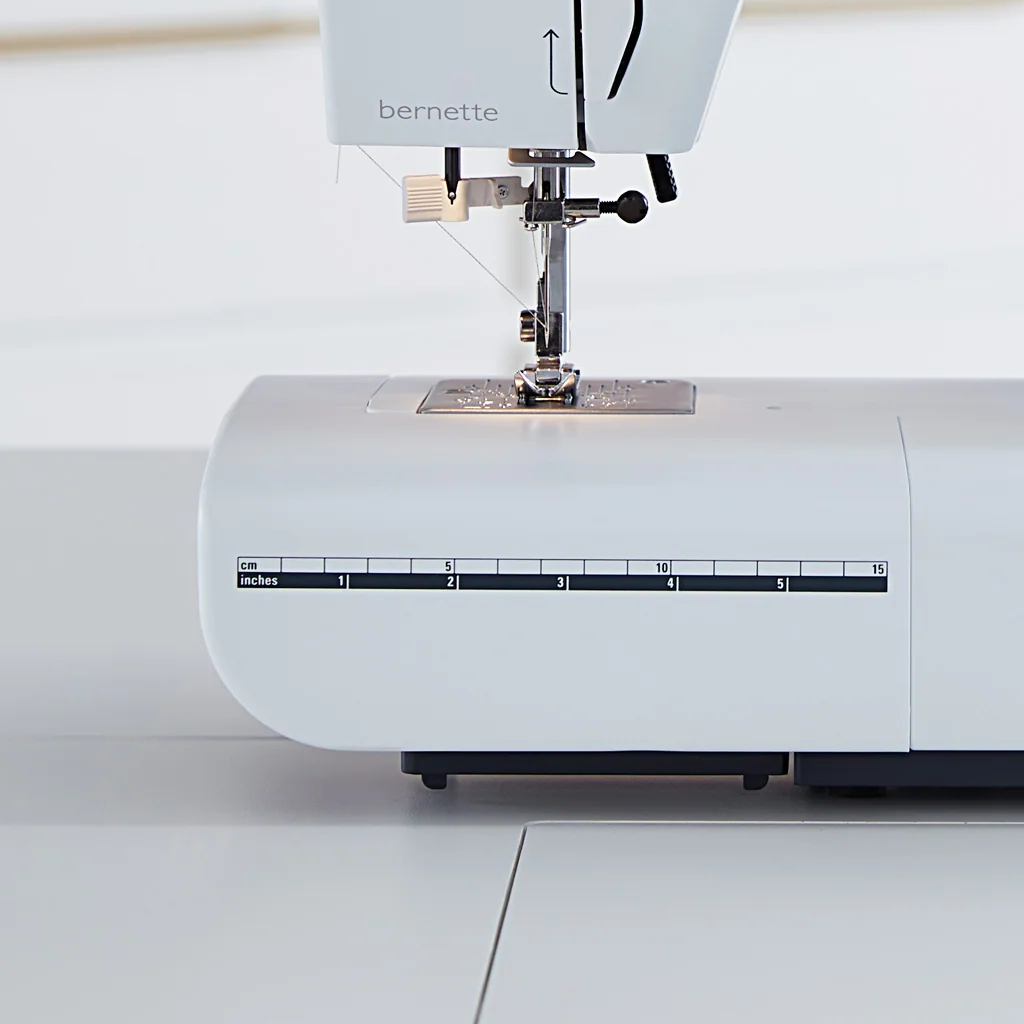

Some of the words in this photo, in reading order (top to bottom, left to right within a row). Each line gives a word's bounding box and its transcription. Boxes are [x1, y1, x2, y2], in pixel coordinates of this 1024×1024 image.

[379, 99, 499, 122] bernette
[240, 560, 257, 571] cm
[445, 561, 452, 572] 5
[655, 562, 669, 574] 10
[871, 563, 885, 576] 15
[240, 574, 278, 586] inches
[337, 575, 344, 586] 1
[446, 576, 454, 587] 2
[556, 577, 564, 588] 3
[666, 577, 674, 589] 4
[777, 578, 784, 589] 5
